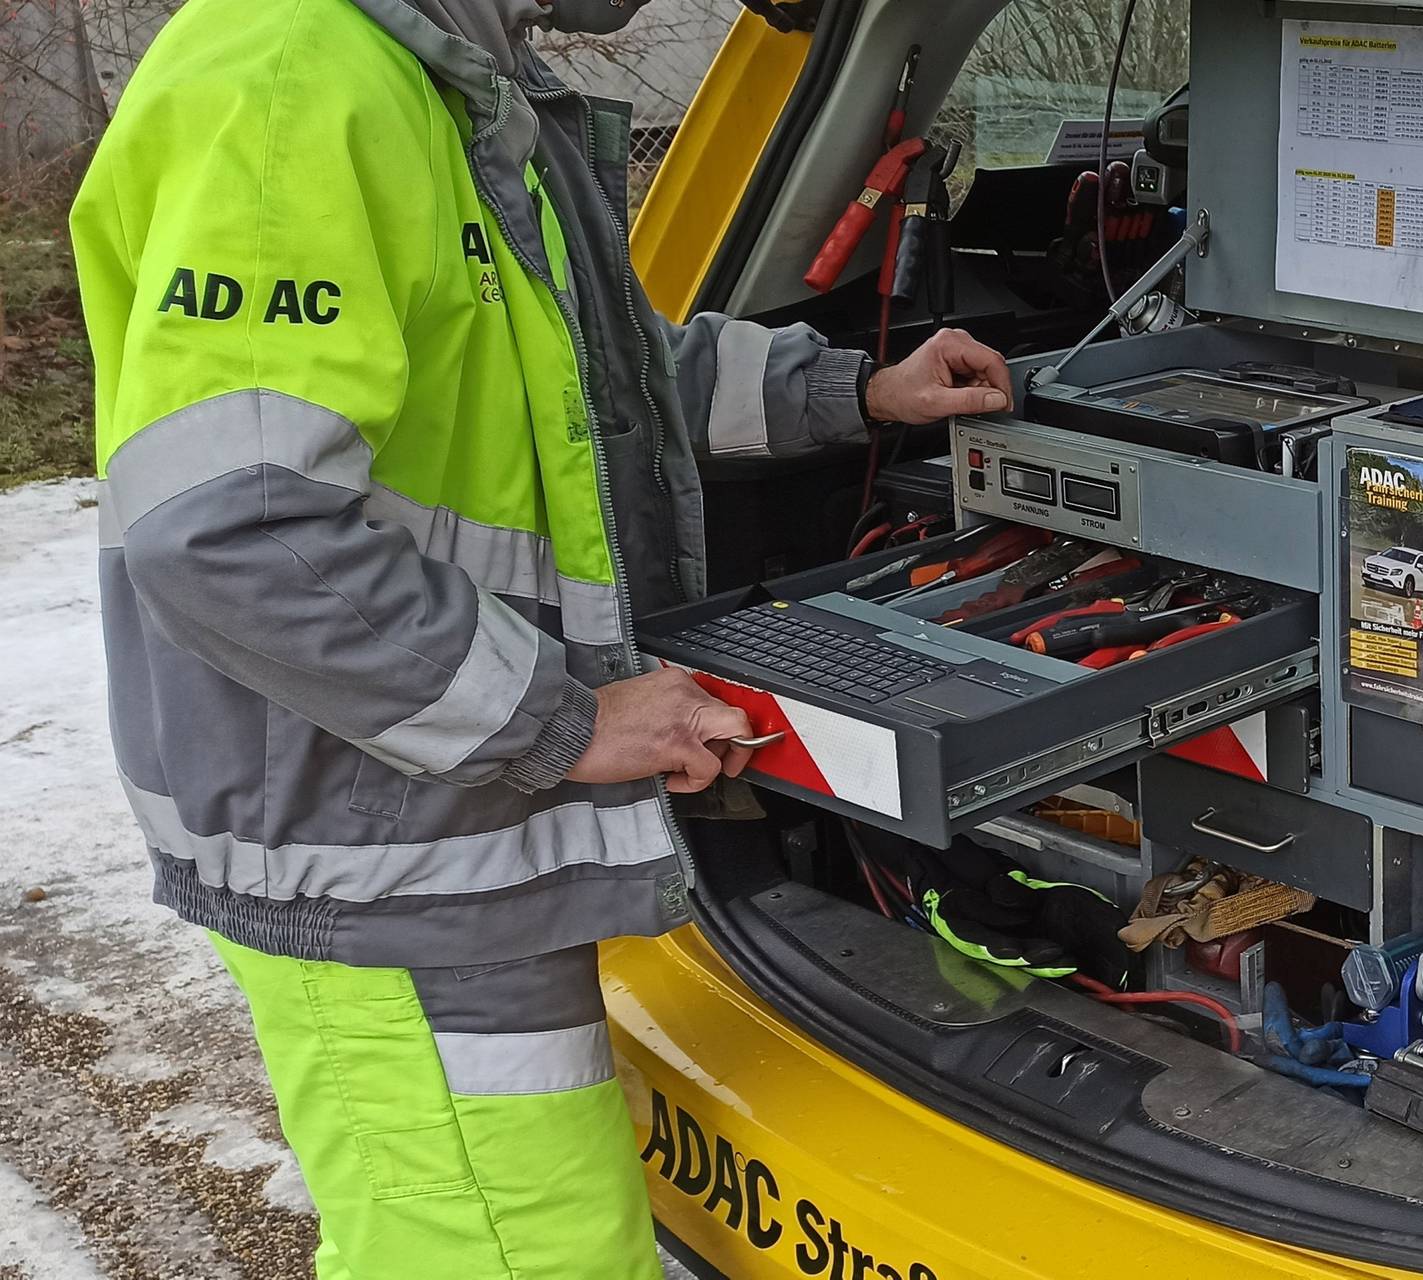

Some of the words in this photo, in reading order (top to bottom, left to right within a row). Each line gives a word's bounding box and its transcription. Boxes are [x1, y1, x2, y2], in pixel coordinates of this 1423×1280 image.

[1351, 40, 1368, 48] ADAC
[1360, 467, 1405, 491] ADAC
[1013, 502, 1049, 518] SPANNUNG
[1366, 491, 1408, 513] Training
[1081, 518, 1106, 530] STROM
[1372, 622, 1402, 635] Sicherheit
[640, 1088, 783, 1249] ADAC
[796, 1199, 937, 1280] Str
